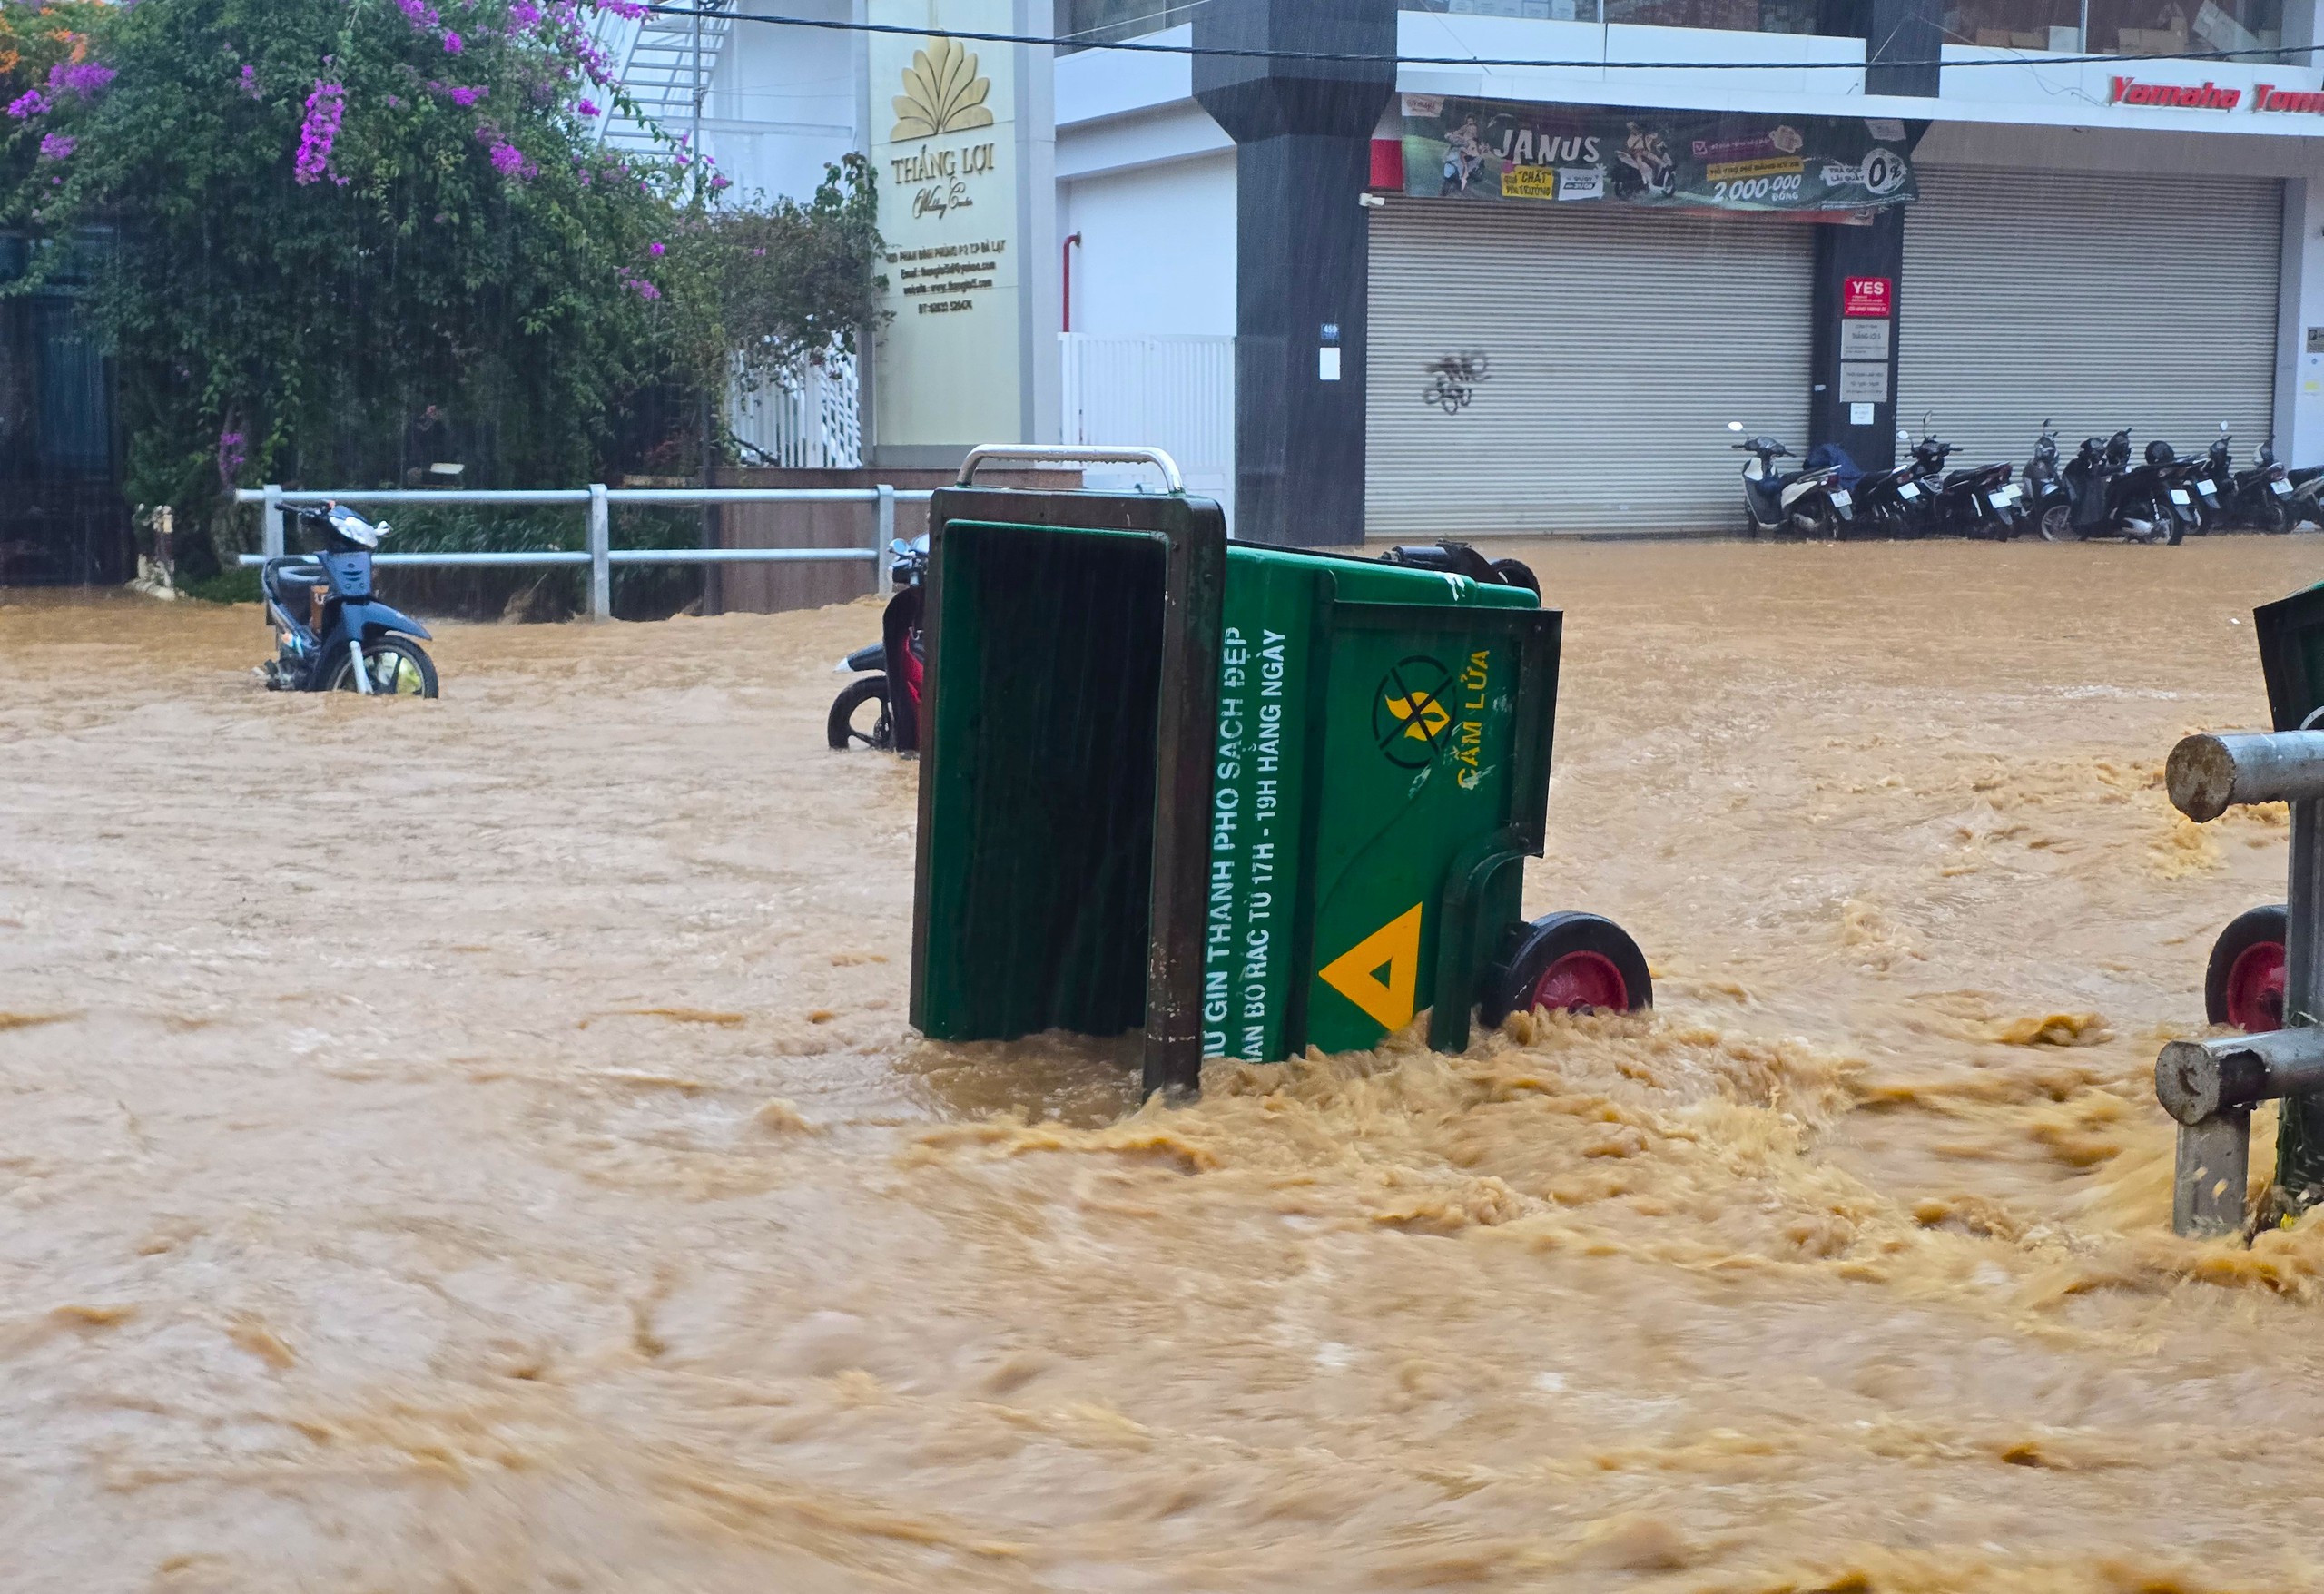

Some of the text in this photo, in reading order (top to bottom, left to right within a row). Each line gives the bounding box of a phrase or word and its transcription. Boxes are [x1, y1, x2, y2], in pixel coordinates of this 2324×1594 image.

[2109, 76, 2240, 109] Yamaha
[1494, 129, 1600, 164] JANUS
[1852, 281, 1884, 295] YES
[1256, 629, 1285, 696] NGÀY
[1460, 650, 1491, 710] LỬA
[1255, 780, 1277, 821] 19H
[1252, 842, 1275, 885] 17H
